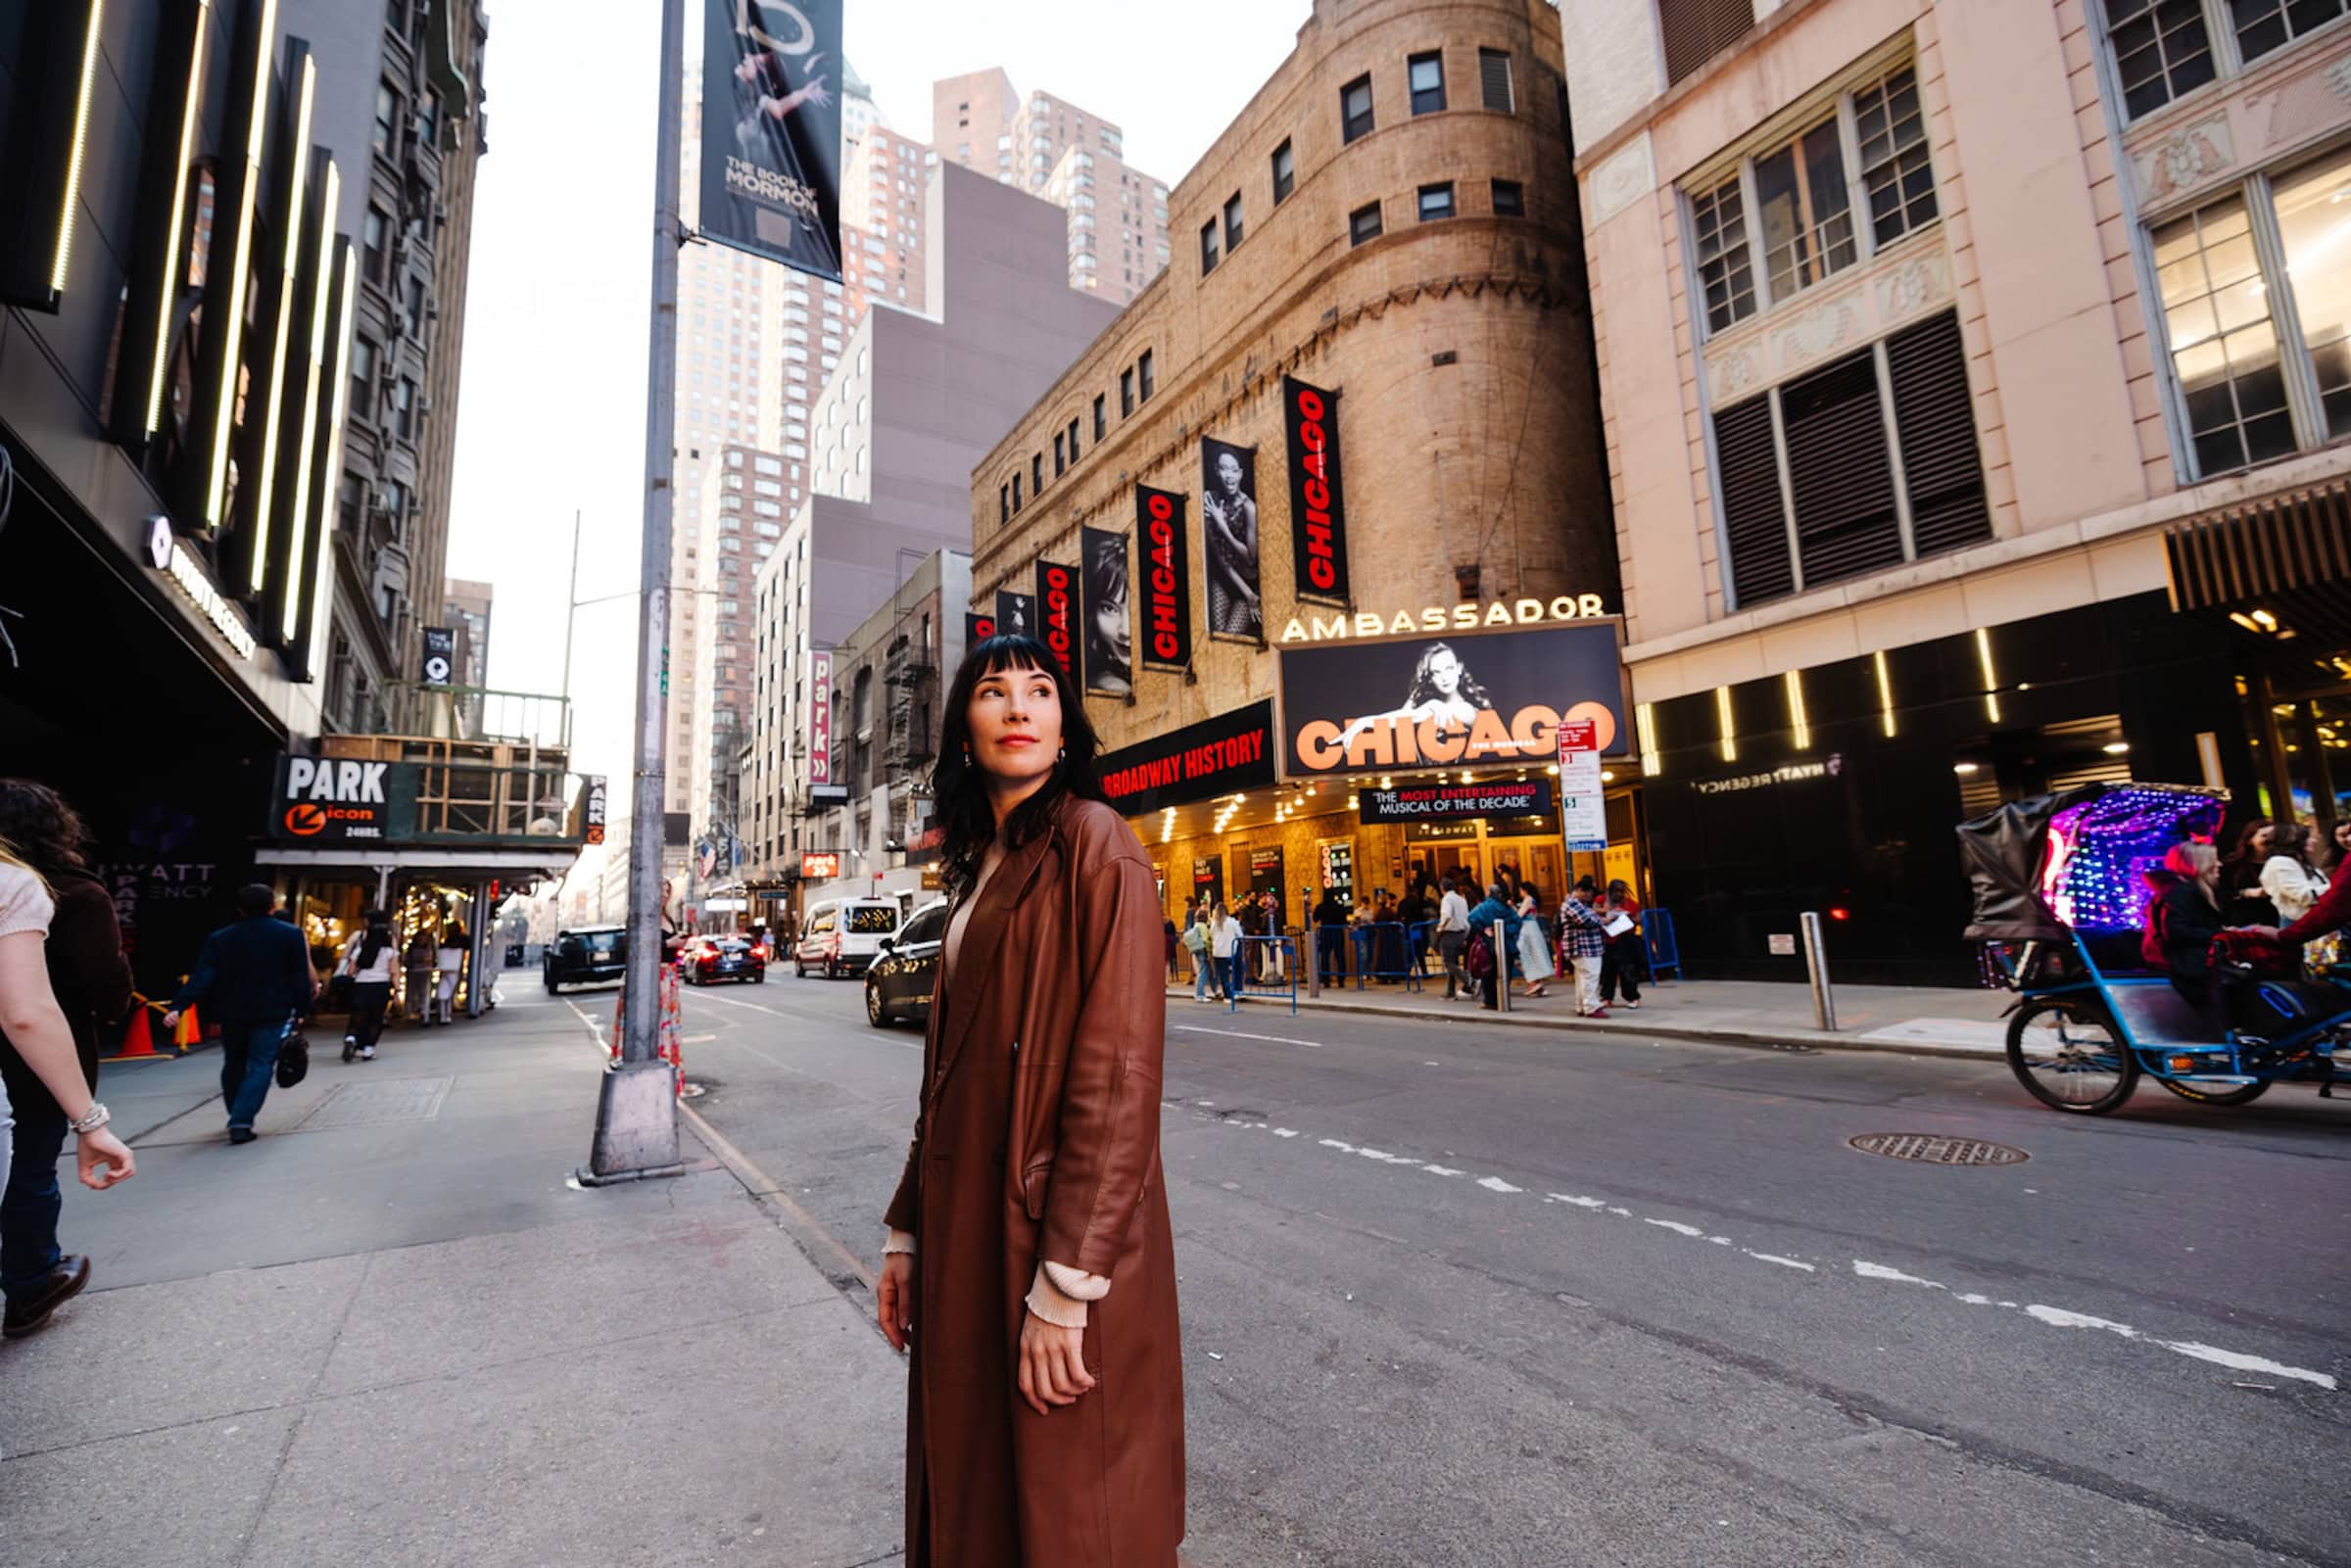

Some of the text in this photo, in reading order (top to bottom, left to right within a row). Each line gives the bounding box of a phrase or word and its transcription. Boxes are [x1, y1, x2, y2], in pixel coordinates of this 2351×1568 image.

[726, 155, 754, 174] THE
[757, 166, 798, 189] BOOK
[799, 185, 817, 200] OF
[726, 166, 818, 216] MORMON
[1298, 389, 1334, 590] CHICAGO
[1148, 494, 1178, 659] CHICAGO
[1046, 567, 1071, 673] ICAGO
[1281, 593, 1605, 642] AMBASSADOR
[813, 659, 829, 752] park
[1296, 700, 1616, 771] CHICAGO
[287, 757, 388, 803] PARK
[1103, 729, 1263, 799] BROADWAY HISTORY
[325, 804, 374, 821] icon
[589, 777, 605, 824] PARK
[1379, 801, 1431, 815] MUSICAL
[1433, 799, 1451, 812] OF
[1454, 798, 1476, 811] THE
[1400, 789, 1437, 801] MOST
[1441, 784, 1537, 800] ENTERTAINING
[805, 855, 837, 867] park
